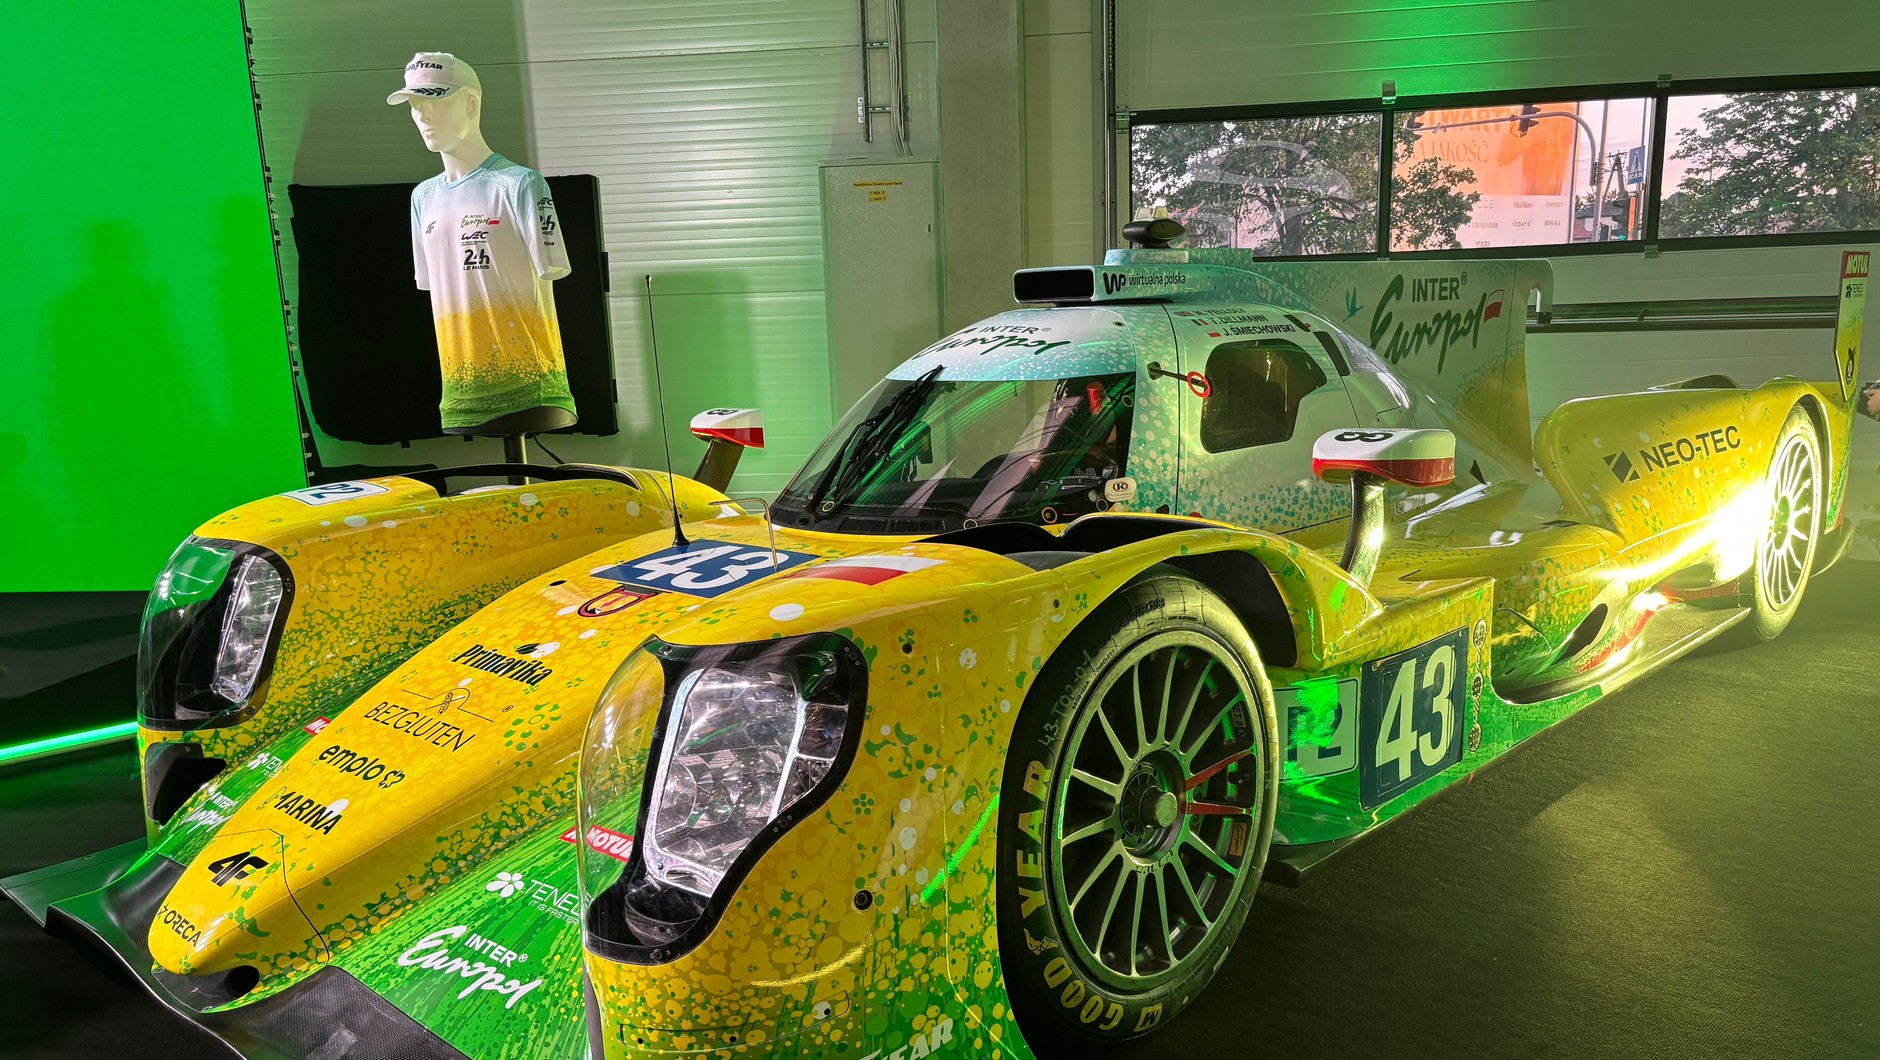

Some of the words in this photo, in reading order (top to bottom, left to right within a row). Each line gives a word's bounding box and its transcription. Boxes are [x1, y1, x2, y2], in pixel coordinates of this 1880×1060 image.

[464, 248, 490, 266] 24h
[1845, 254, 1869, 275] MOTUL
[1129, 273, 1162, 286] wirtualna
[1164, 272, 1186, 287] polska
[1220, 314, 1269, 324] DILLMANN
[1230, 324, 1297, 336] ŚMIECHOWSKI
[1369, 274, 1487, 375] Europol
[1639, 425, 1741, 472] NEO-TEC
[633, 545, 790, 590] 43
[451, 643, 554, 687] Primavika
[364, 701, 476, 753] BEZGLUTEN
[1375, 645, 1458, 782] 43
[318, 744, 386, 781] emplo
[268, 788, 342, 836] MARINA
[208, 851, 269, 887] 4F
[163, 910, 202, 948] ORECA
[398, 925, 543, 1010] Europol
